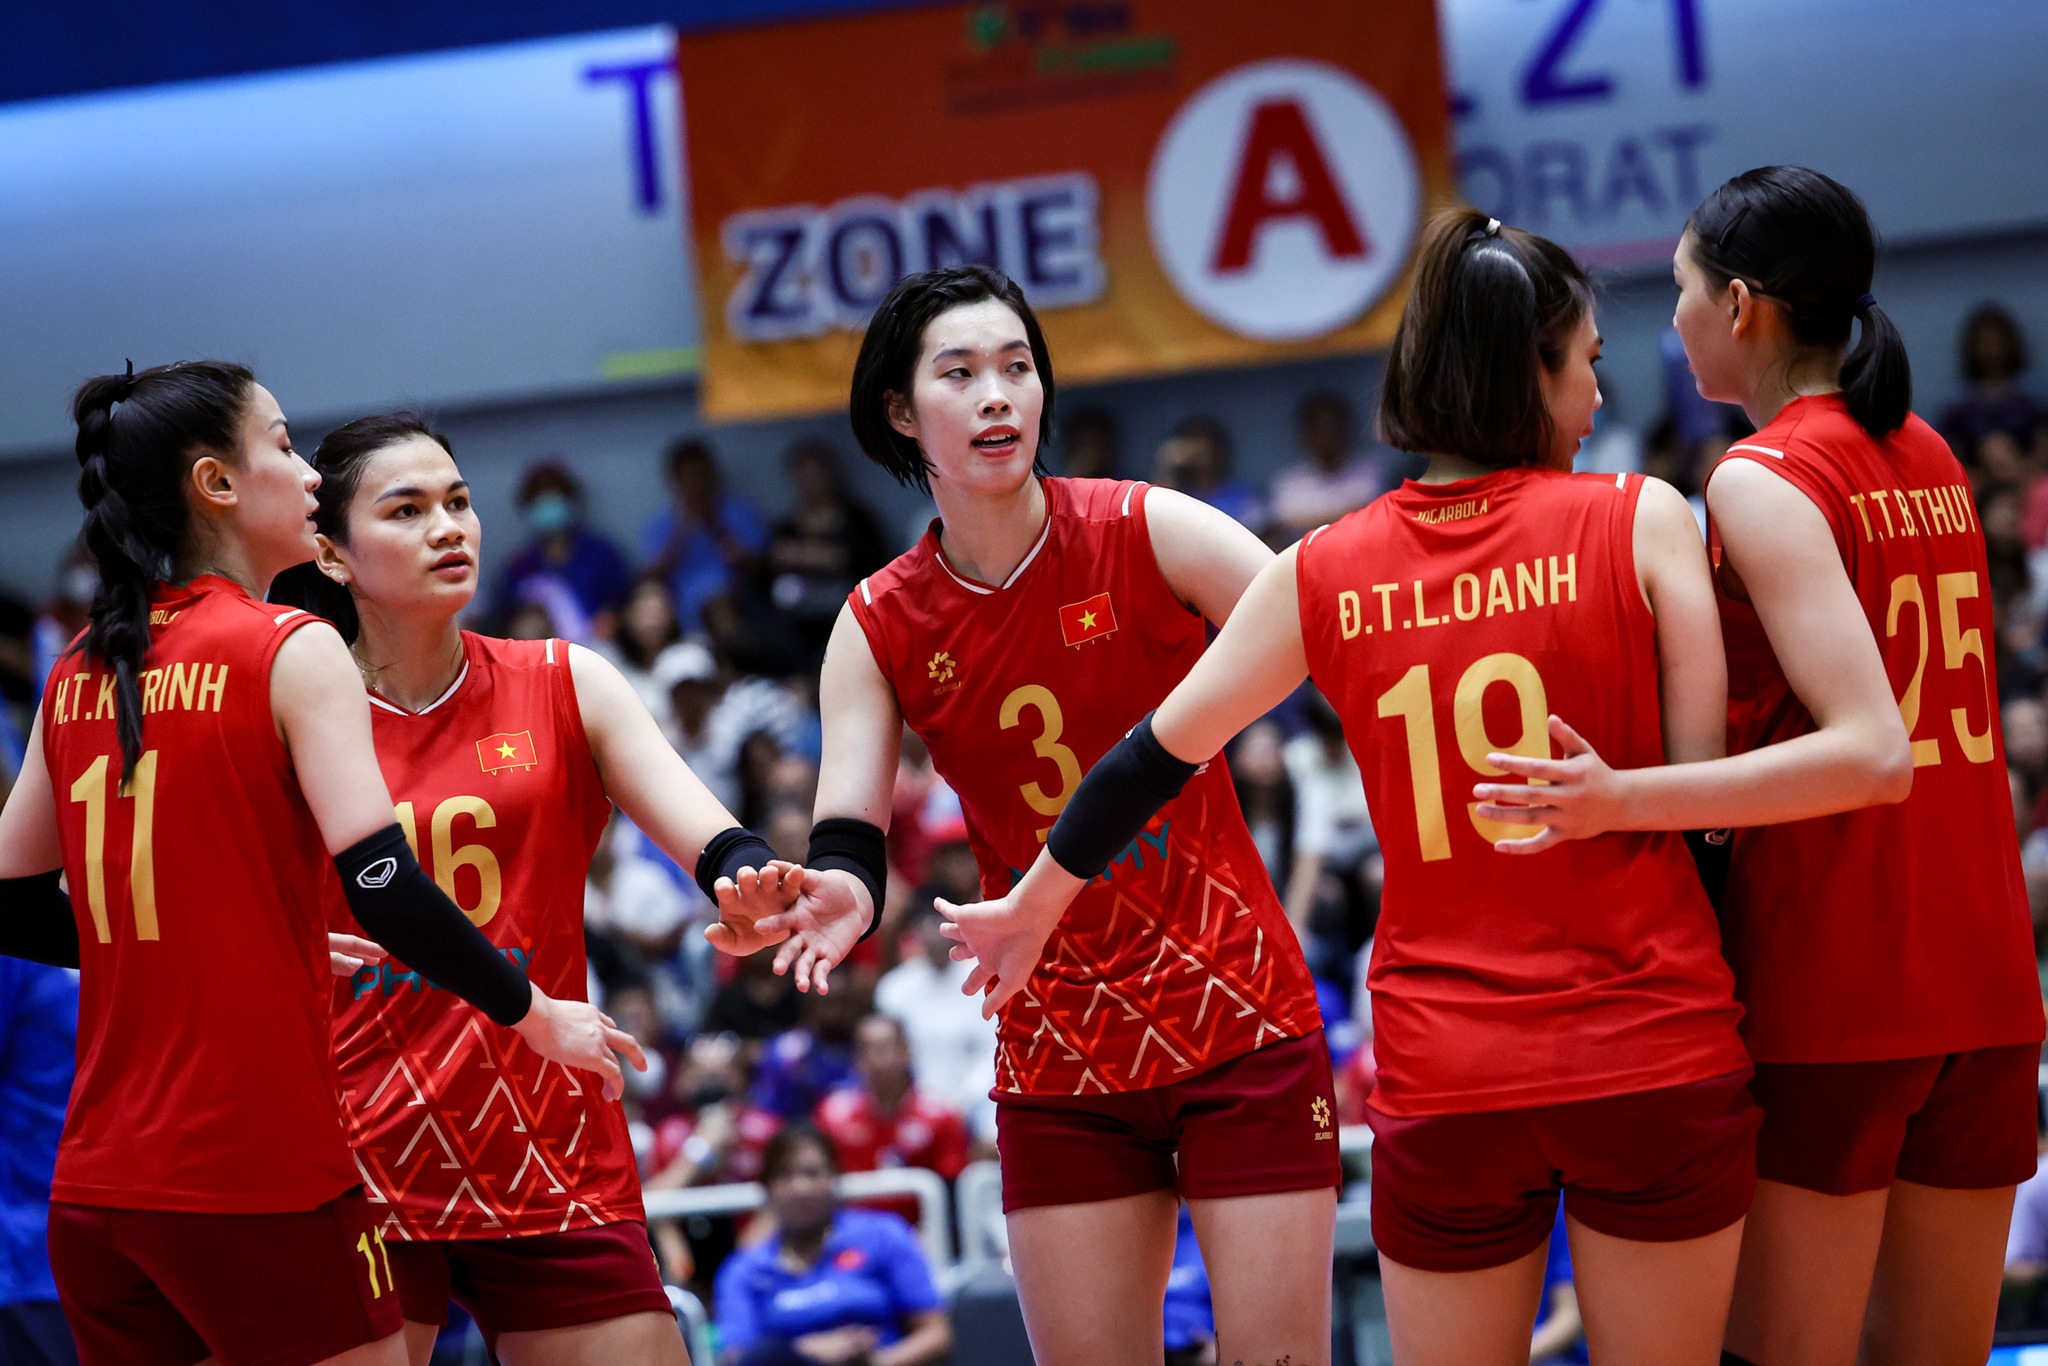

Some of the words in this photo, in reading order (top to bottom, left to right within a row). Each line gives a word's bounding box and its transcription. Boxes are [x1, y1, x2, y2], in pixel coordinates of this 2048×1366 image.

[732, 182, 1094, 330] ZONE
[1210, 95, 1373, 277] A
[1337, 552, 1577, 641] Đ.T.L.OANH
[1886, 571, 1995, 768] 25
[999, 684, 1083, 817] 3
[1376, 652, 1553, 863] 19
[70, 750, 160, 944] 11
[356, 1224, 394, 1300] 11
